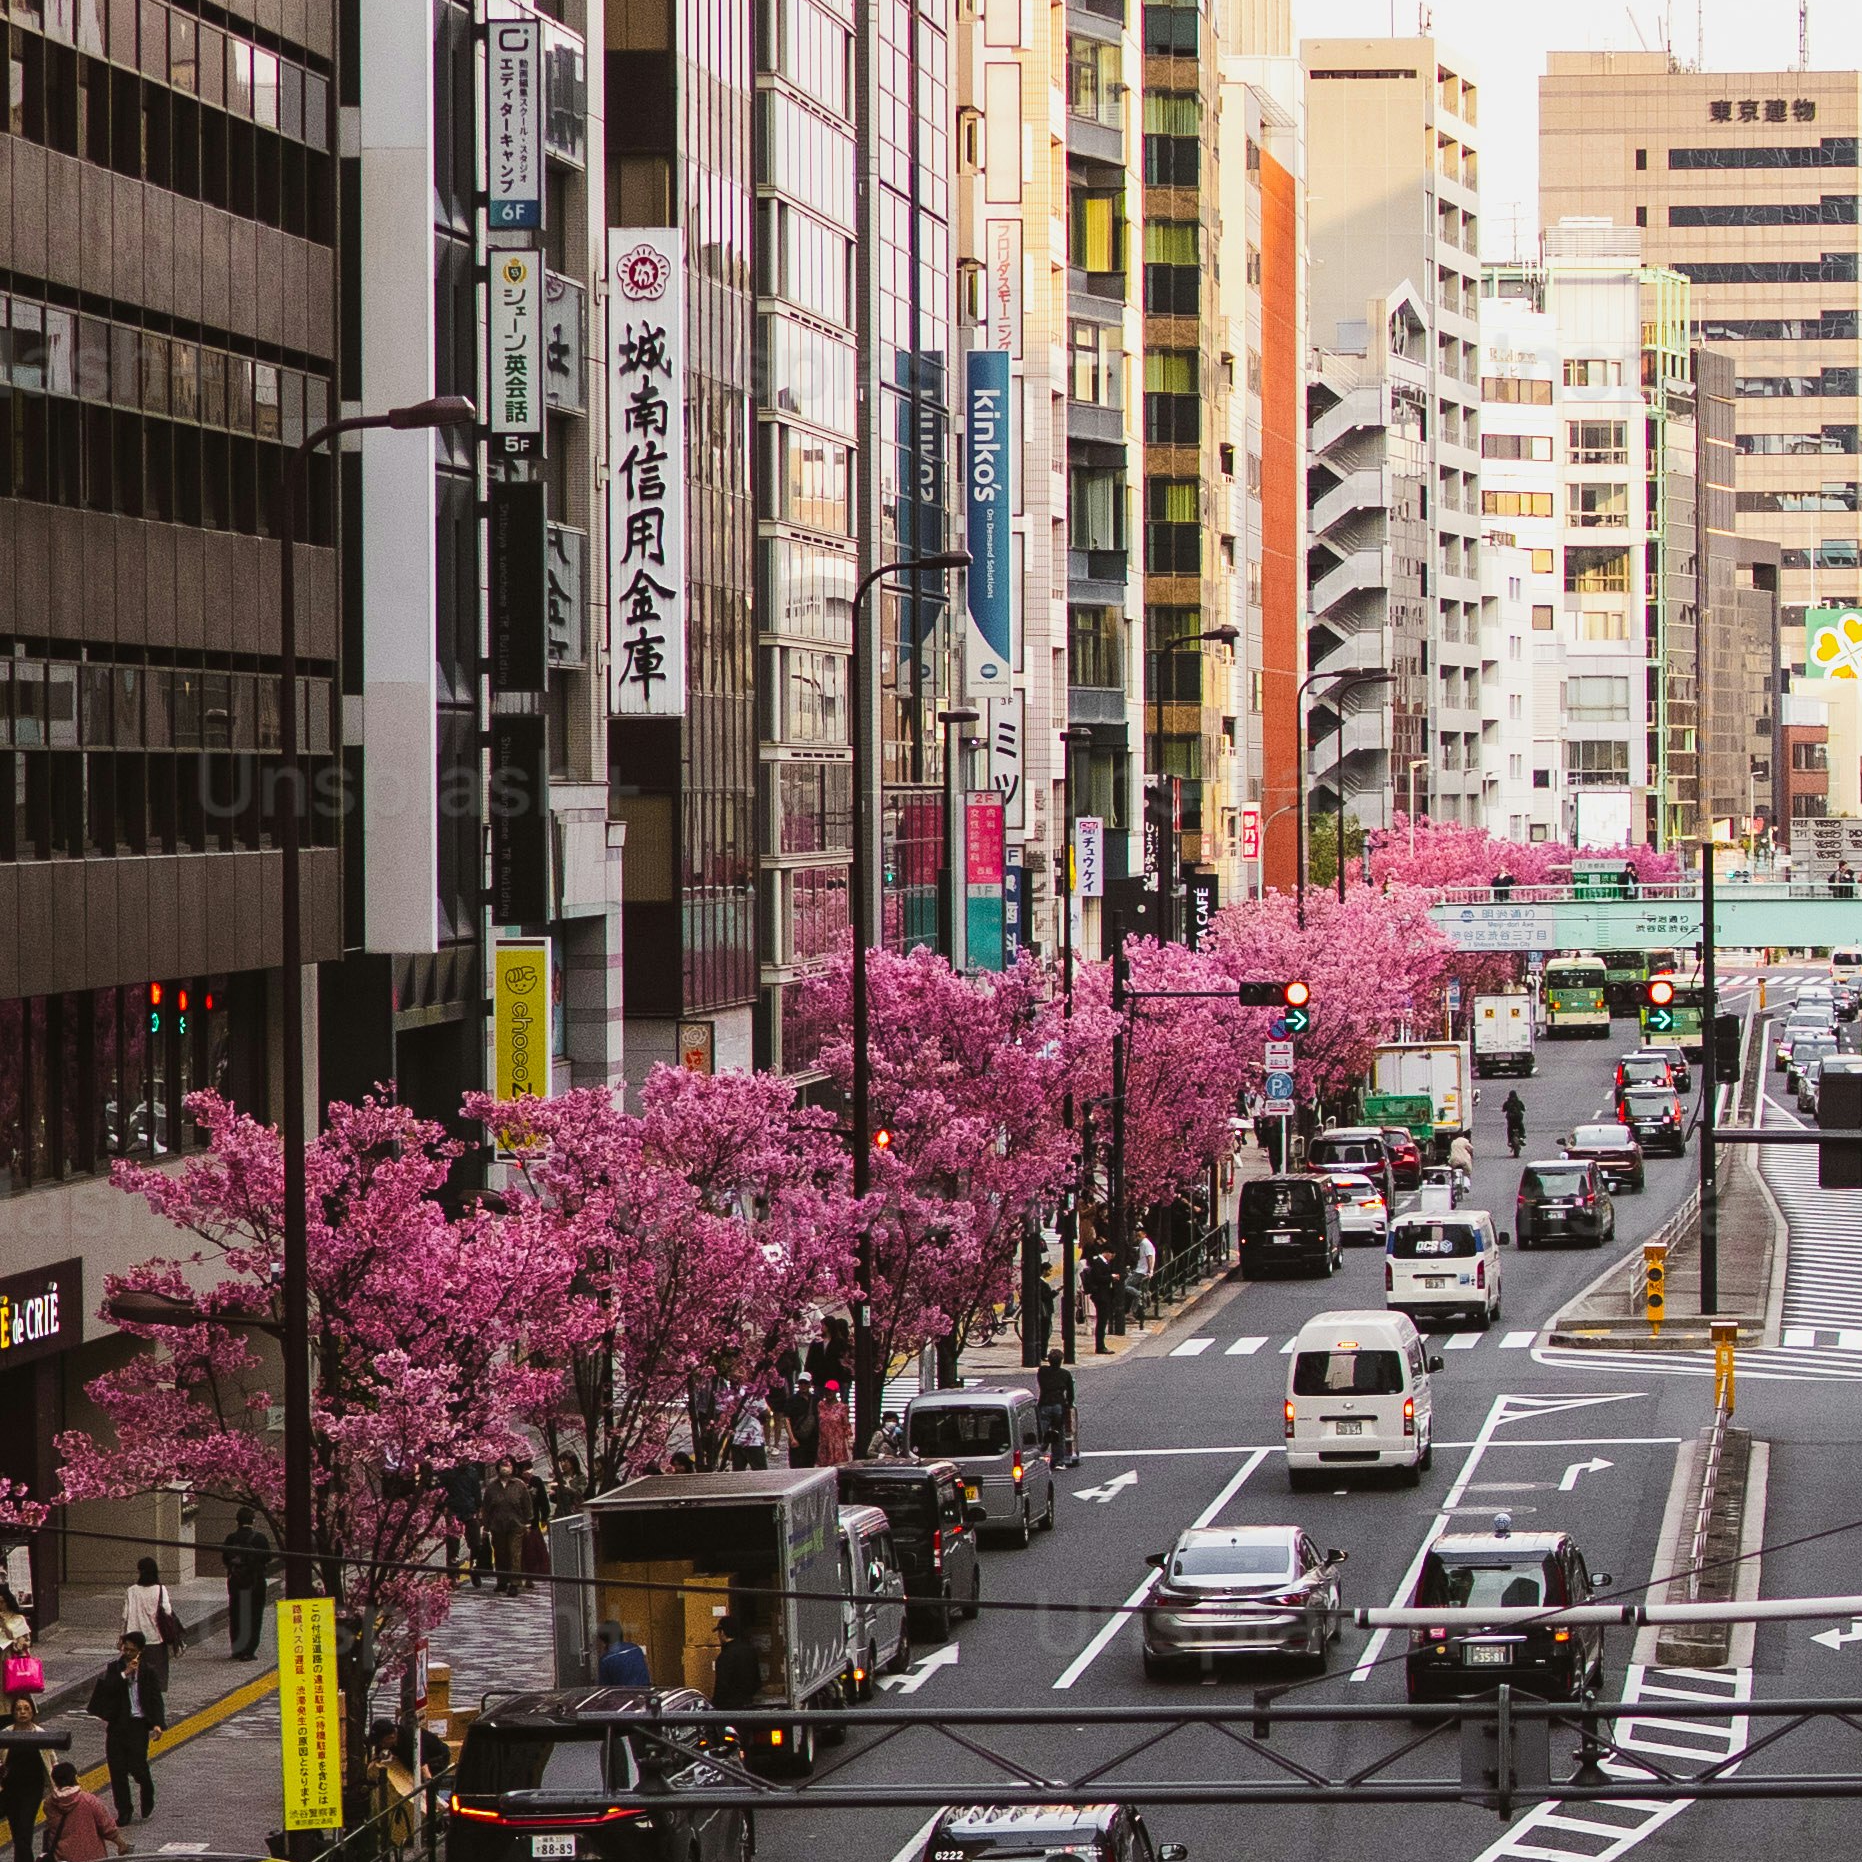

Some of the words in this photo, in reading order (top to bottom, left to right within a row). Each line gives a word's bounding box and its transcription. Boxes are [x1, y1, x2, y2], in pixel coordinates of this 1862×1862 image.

[1710, 99, 1816, 123] 東京建物
[500, 58, 514, 193] エディターキャンプ
[502, 204, 525, 221] 6F
[503, 288, 528, 424] シェーン英会話
[504, 436, 530, 453] 5F
[974, 390, 1002, 502] kinko's
[618, 320, 675, 701] 城南信用金庫
[1082, 837, 1096, 893] チュウケイ
[1636, 925, 1722, 933] 渋谷区渋谷三目
[512, 1002, 533, 1101] chocoZ
[1415, 1240, 1439, 1252] OCS
[541, 1843, 574, 1855] 88-89
[935, 1851, 964, 1861] 6222
